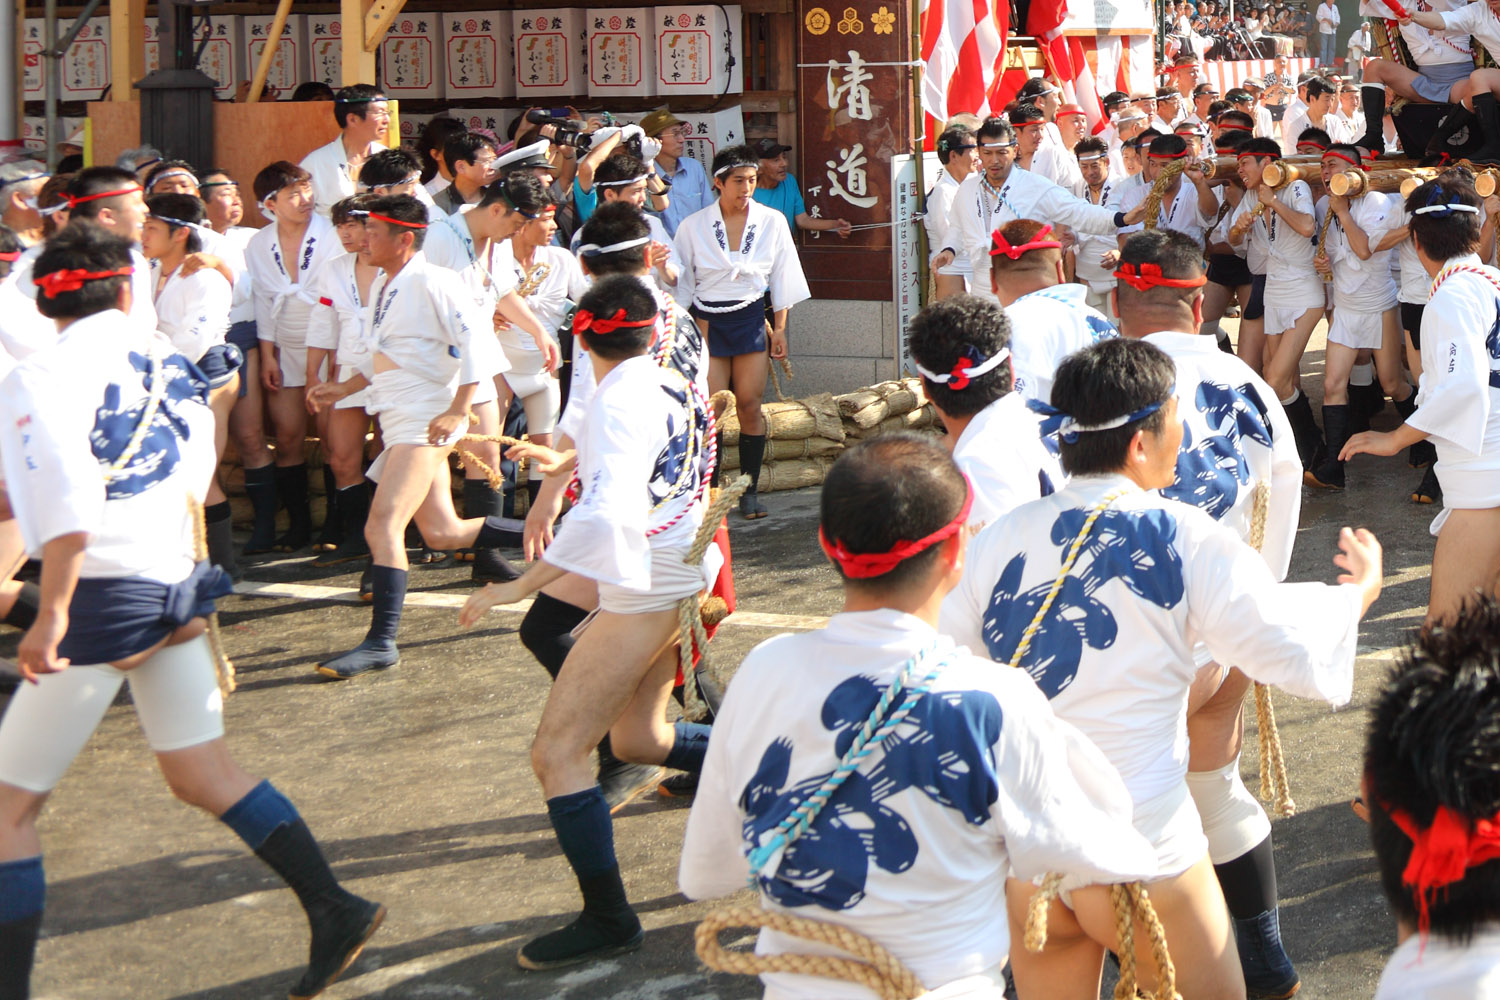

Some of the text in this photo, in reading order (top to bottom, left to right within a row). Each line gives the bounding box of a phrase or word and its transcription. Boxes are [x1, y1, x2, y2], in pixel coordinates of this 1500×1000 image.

[458, 53, 470, 86] ふくや
[528, 51, 540, 84] ふくや
[601, 50, 612, 83] ふくや
[671, 48, 682, 81] ふくや
[827, 50, 878, 208] 清道
